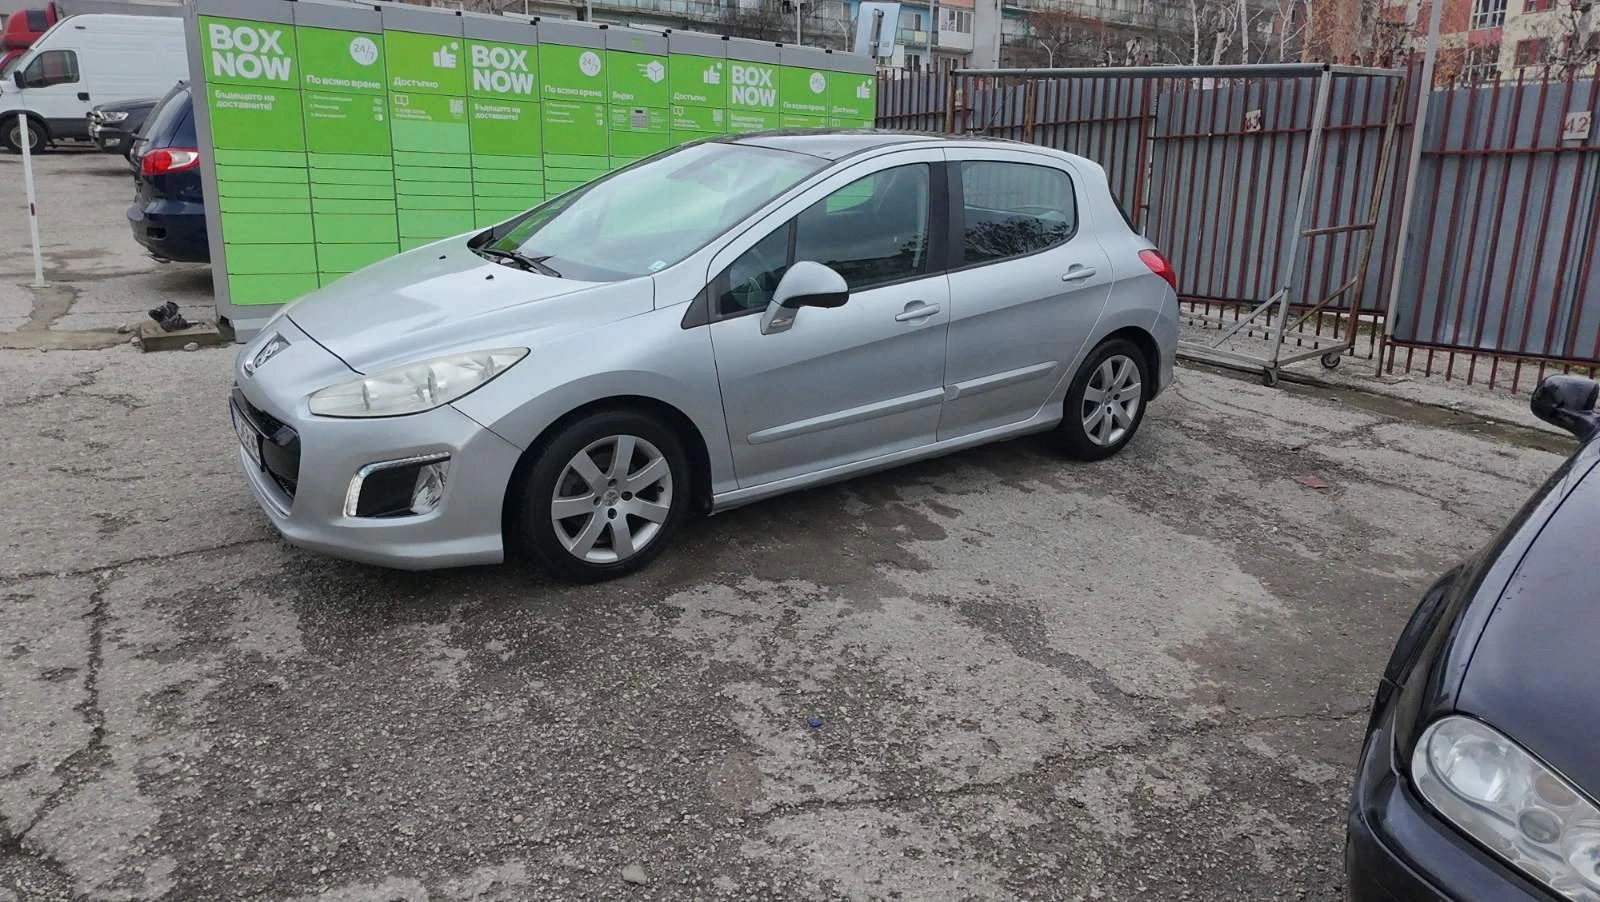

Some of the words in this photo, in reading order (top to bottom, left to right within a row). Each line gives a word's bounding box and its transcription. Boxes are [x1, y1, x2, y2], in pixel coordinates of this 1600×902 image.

[208, 23, 284, 56] BOX
[211, 51, 292, 81] NOW
[471, 44, 528, 71] BOX
[306, 74, 321, 85] По
[393, 76, 439, 89] Достъпно
[473, 69, 534, 95] NOW
[731, 65, 773, 88] BOX
[544, 84, 555, 94] По
[732, 86, 776, 107] NOW
[1563, 116, 1588, 133] 42
